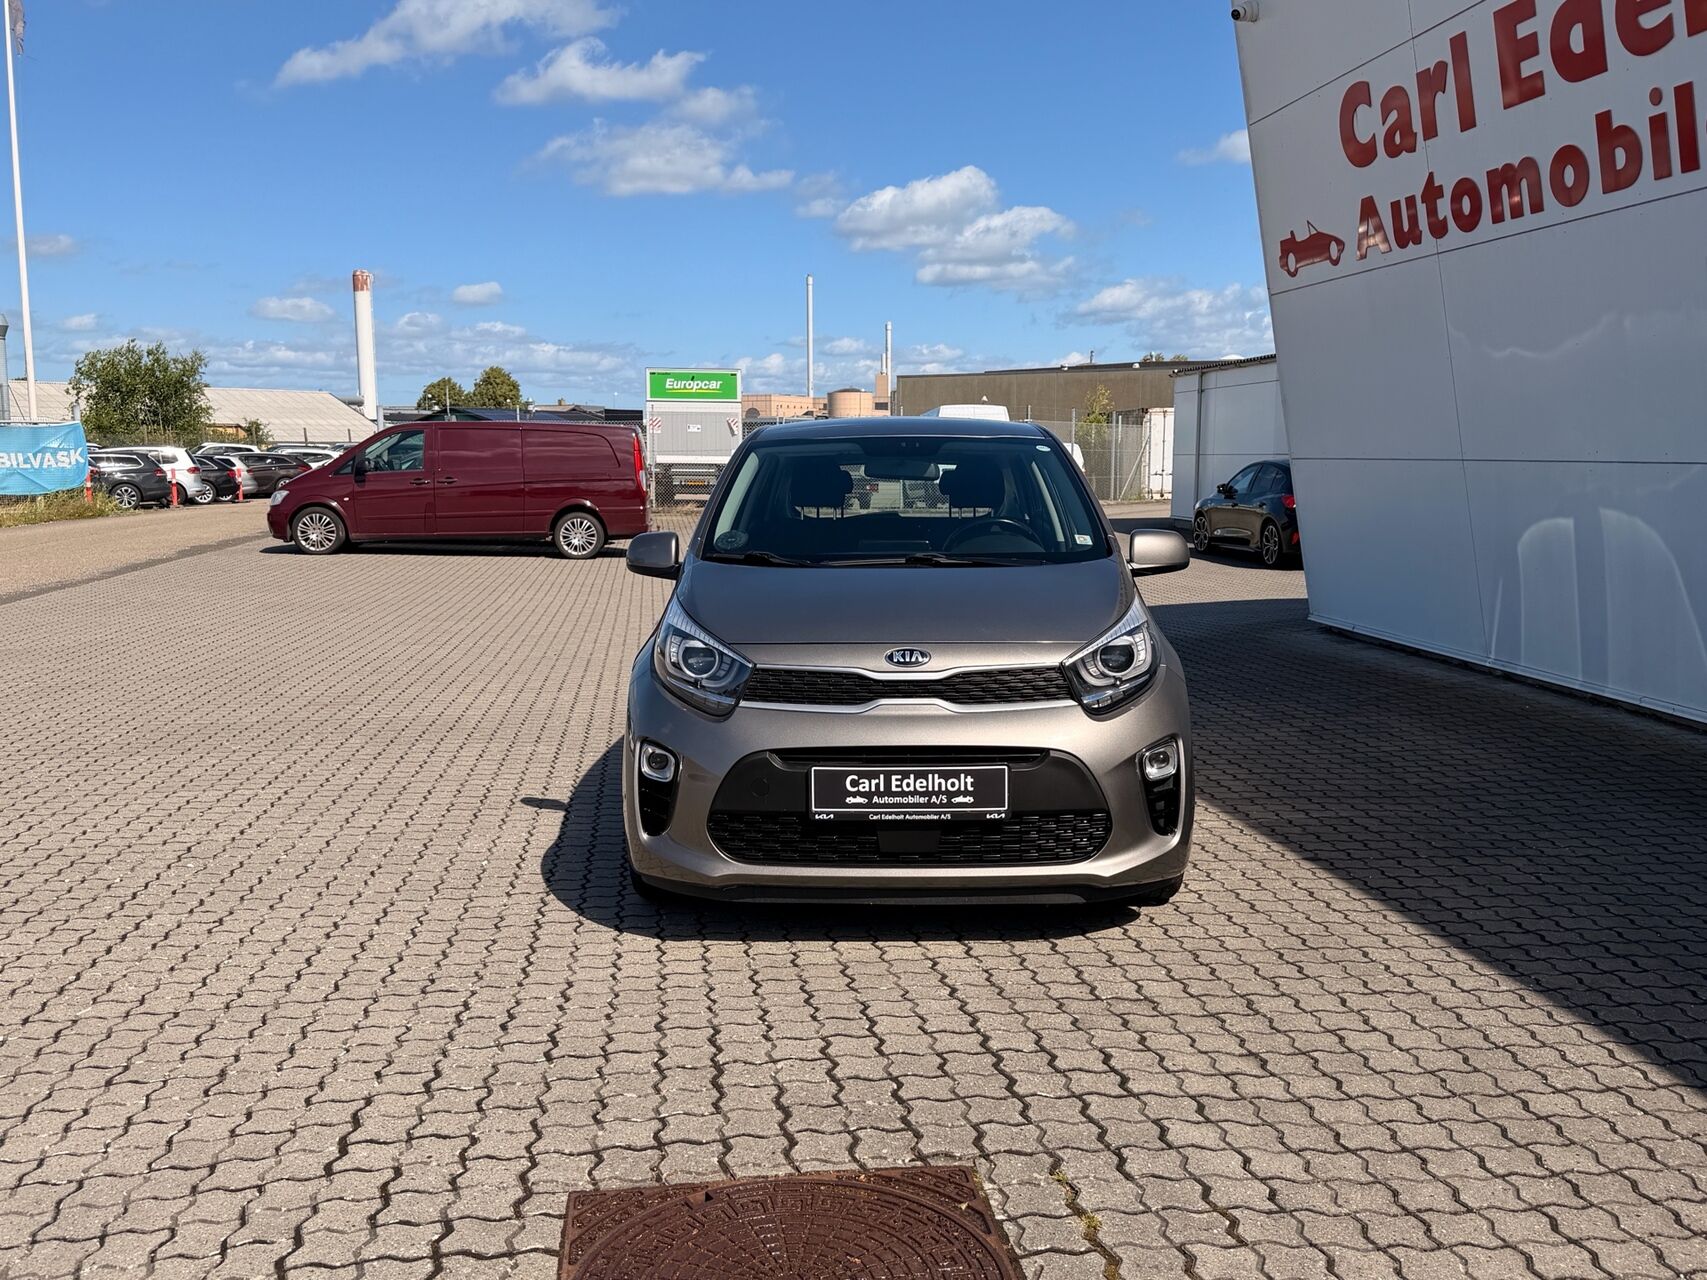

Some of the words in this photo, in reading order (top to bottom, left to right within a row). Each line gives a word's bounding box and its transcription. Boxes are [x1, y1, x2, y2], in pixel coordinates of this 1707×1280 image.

[1339, 31, 1477, 168] Carl
[1356, 81, 1707, 261] Automobil
[665, 376, 723, 392] Europcar
[0, 447, 85, 469] BILVASK
[892, 650, 929, 662] KIA
[845, 774, 885, 792] Carl
[891, 774, 974, 792] Edelholt
[872, 795, 928, 804] Automobiler
[930, 795, 947, 804] A/S
